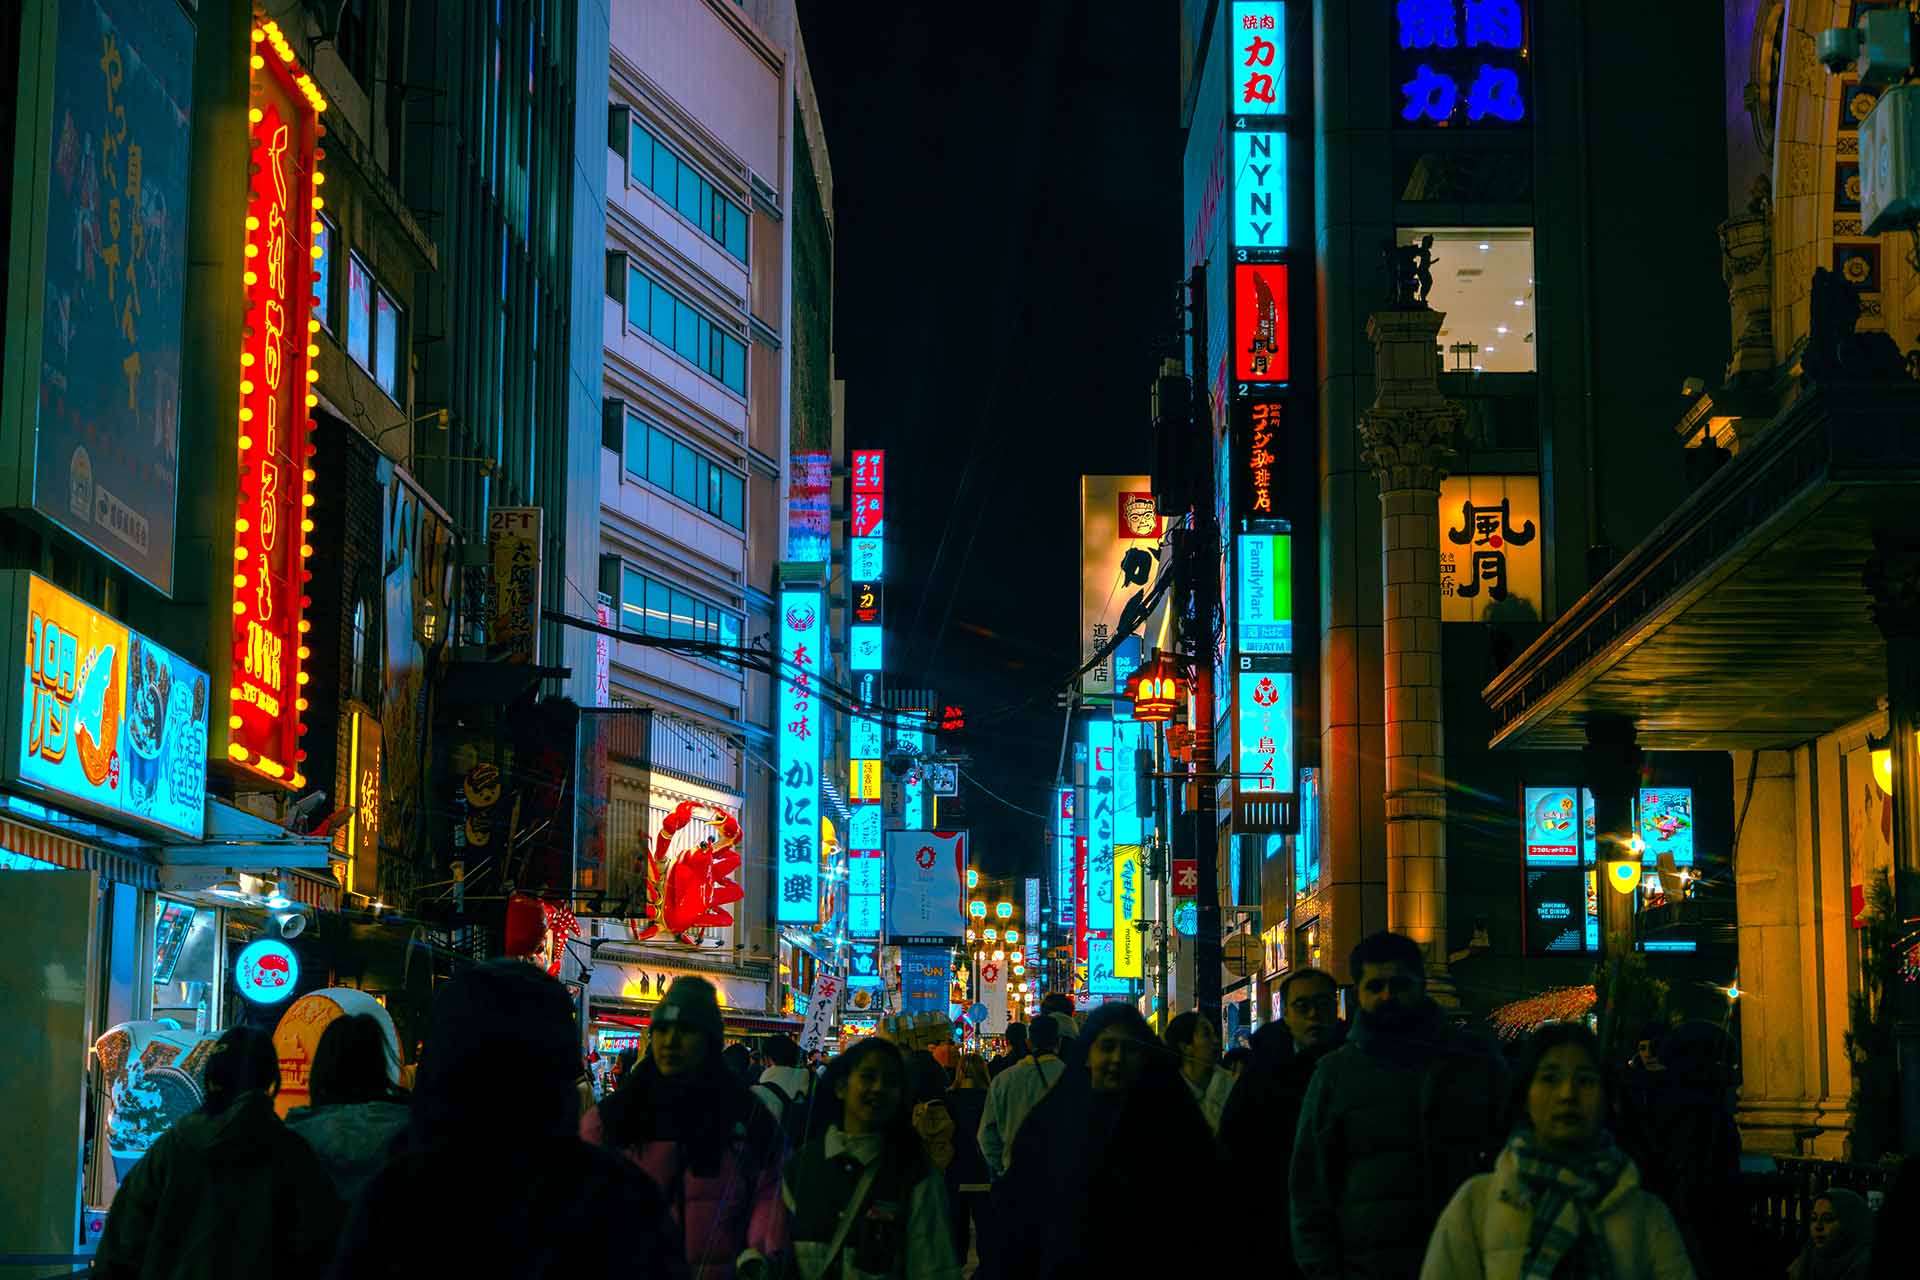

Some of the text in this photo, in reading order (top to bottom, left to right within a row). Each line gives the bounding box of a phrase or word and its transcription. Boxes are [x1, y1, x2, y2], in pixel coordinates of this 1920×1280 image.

[1243, 14, 1275, 30] 焼肉
[1244, 36, 1276, 104] 力丸
[1401, 63, 1525, 121] 力丸
[1235, 117, 1246, 129] 4
[1249, 134, 1273, 245] NYNY
[1236, 249, 1248, 262] 3
[1238, 384, 1249, 396] 2
[855, 455, 867, 537] ダイニングバー
[869, 455, 880, 511] ダーツ &
[492, 513, 516, 529] 2F
[1241, 519, 1247, 532] 1
[1448, 497, 1536, 601] 風月
[1249, 540, 1264, 620] FamilyMart
[1240, 657, 1251, 670] B
[788, 643, 812, 741] 本場の味
[1257, 736, 1277, 790] 鳥メロ
